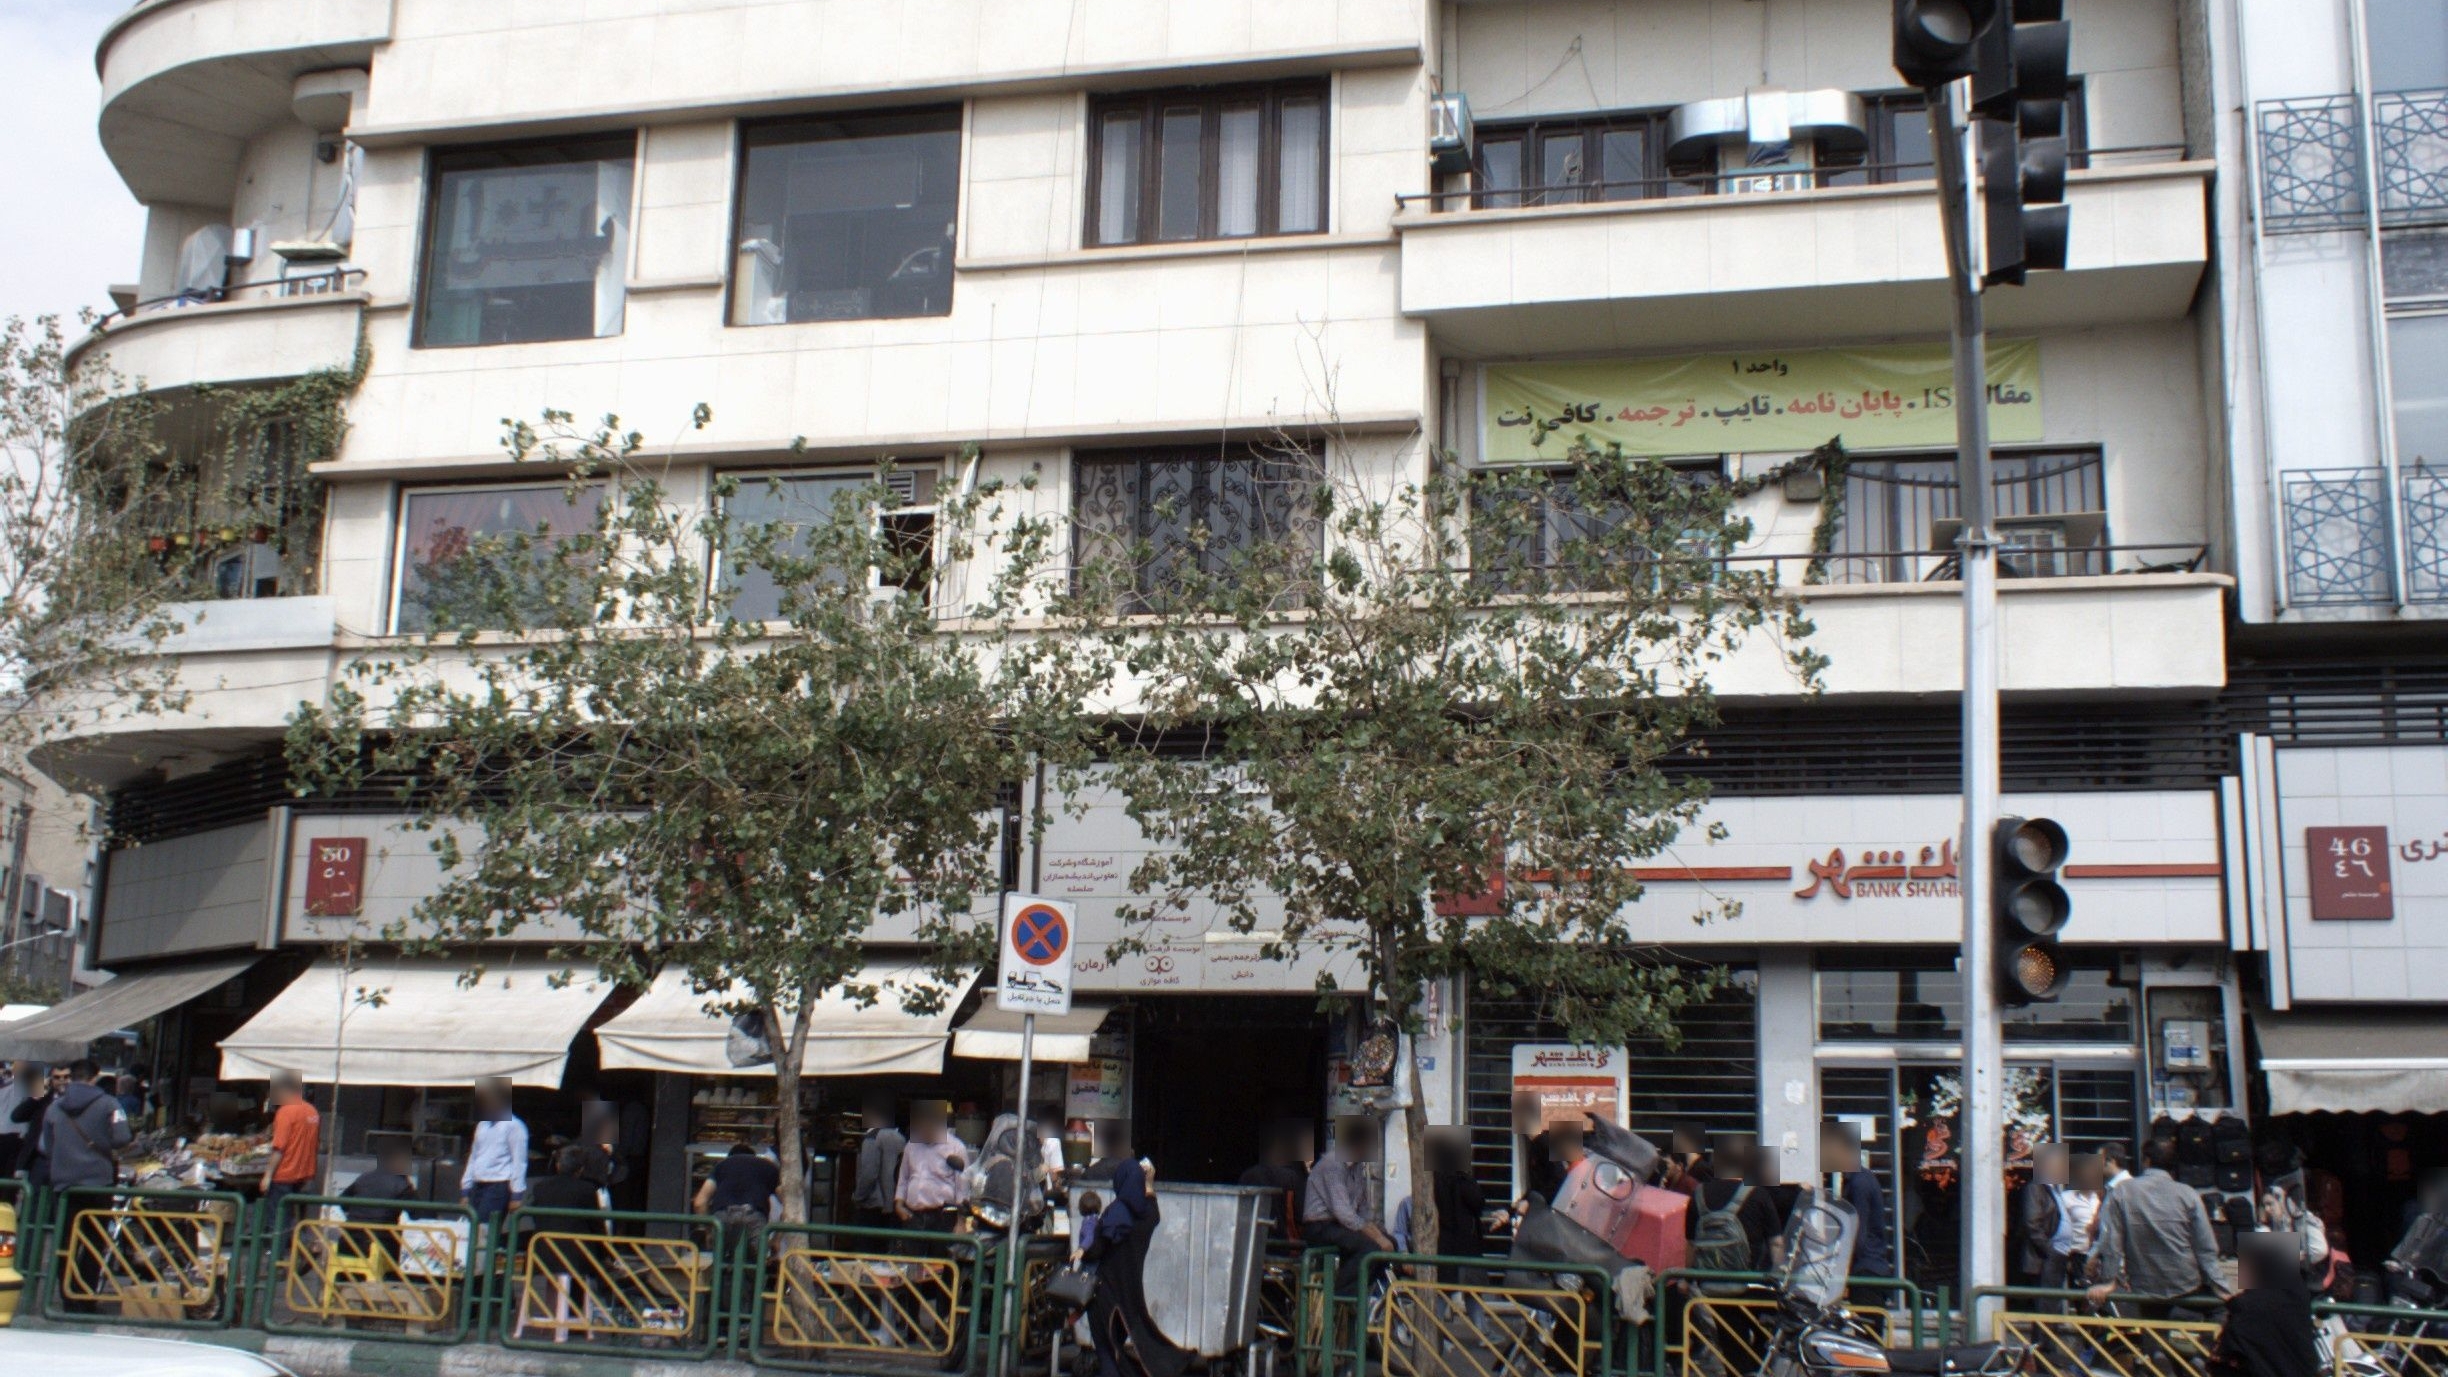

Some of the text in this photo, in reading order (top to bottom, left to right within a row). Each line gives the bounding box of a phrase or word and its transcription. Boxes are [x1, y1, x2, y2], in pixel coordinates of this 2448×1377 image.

[1746, 358, 1789, 376] واحد
[1713, 394, 1771, 427] تایپ
[1788, 391, 1836, 416] نامه
[1840, 389, 1902, 420] پایان
[1922, 387, 1953, 410] IS
[1497, 405, 1534, 428] نت
[1546, 402, 1600, 431] کافی
[1617, 398, 1696, 427] ترجمه
[2328, 836, 2372, 857] 46
[1794, 847, 1907, 899] شهر
[1856, 881, 1902, 898] BANK
